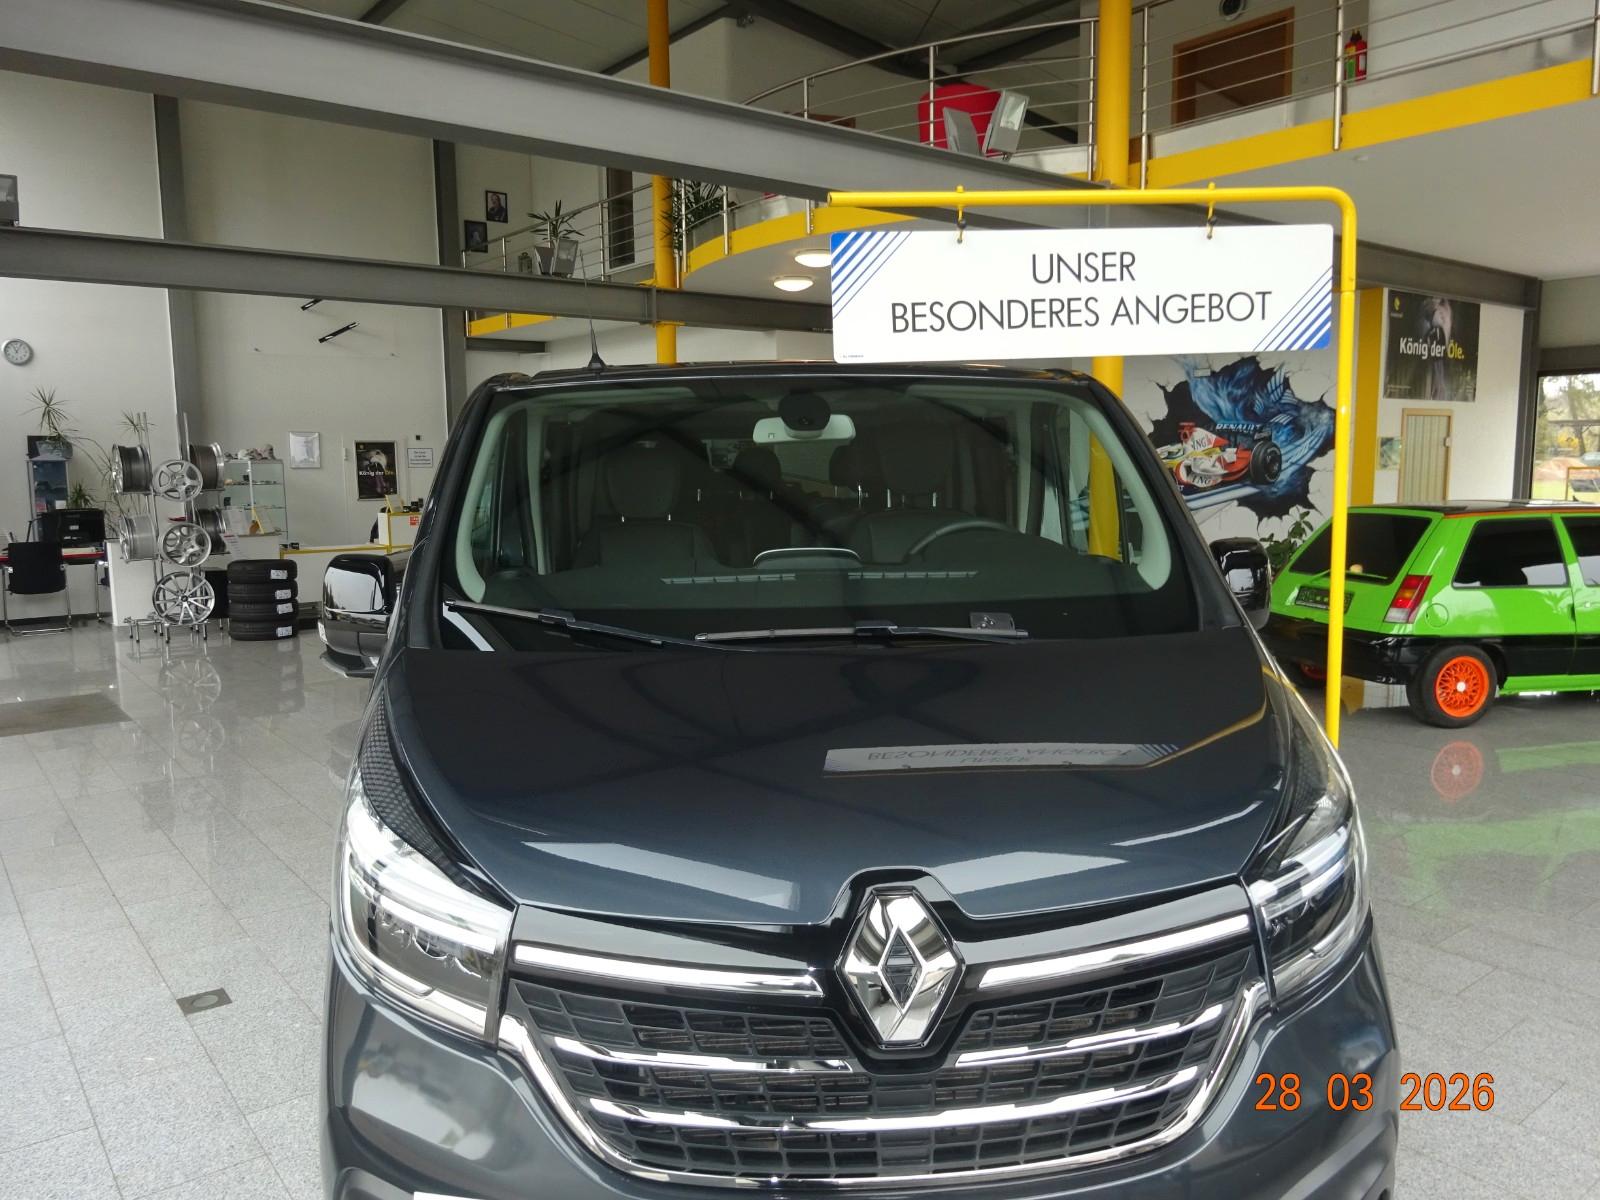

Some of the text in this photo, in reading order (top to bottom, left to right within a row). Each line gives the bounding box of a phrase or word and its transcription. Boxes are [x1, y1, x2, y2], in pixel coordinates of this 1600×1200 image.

[1032, 251, 1136, 284] UNSER
[891, 291, 1272, 333] BESONDERES ANGEBOT
[1400, 337, 1465, 359] König der Öle.
[1215, 423, 1262, 433] RENAULT
